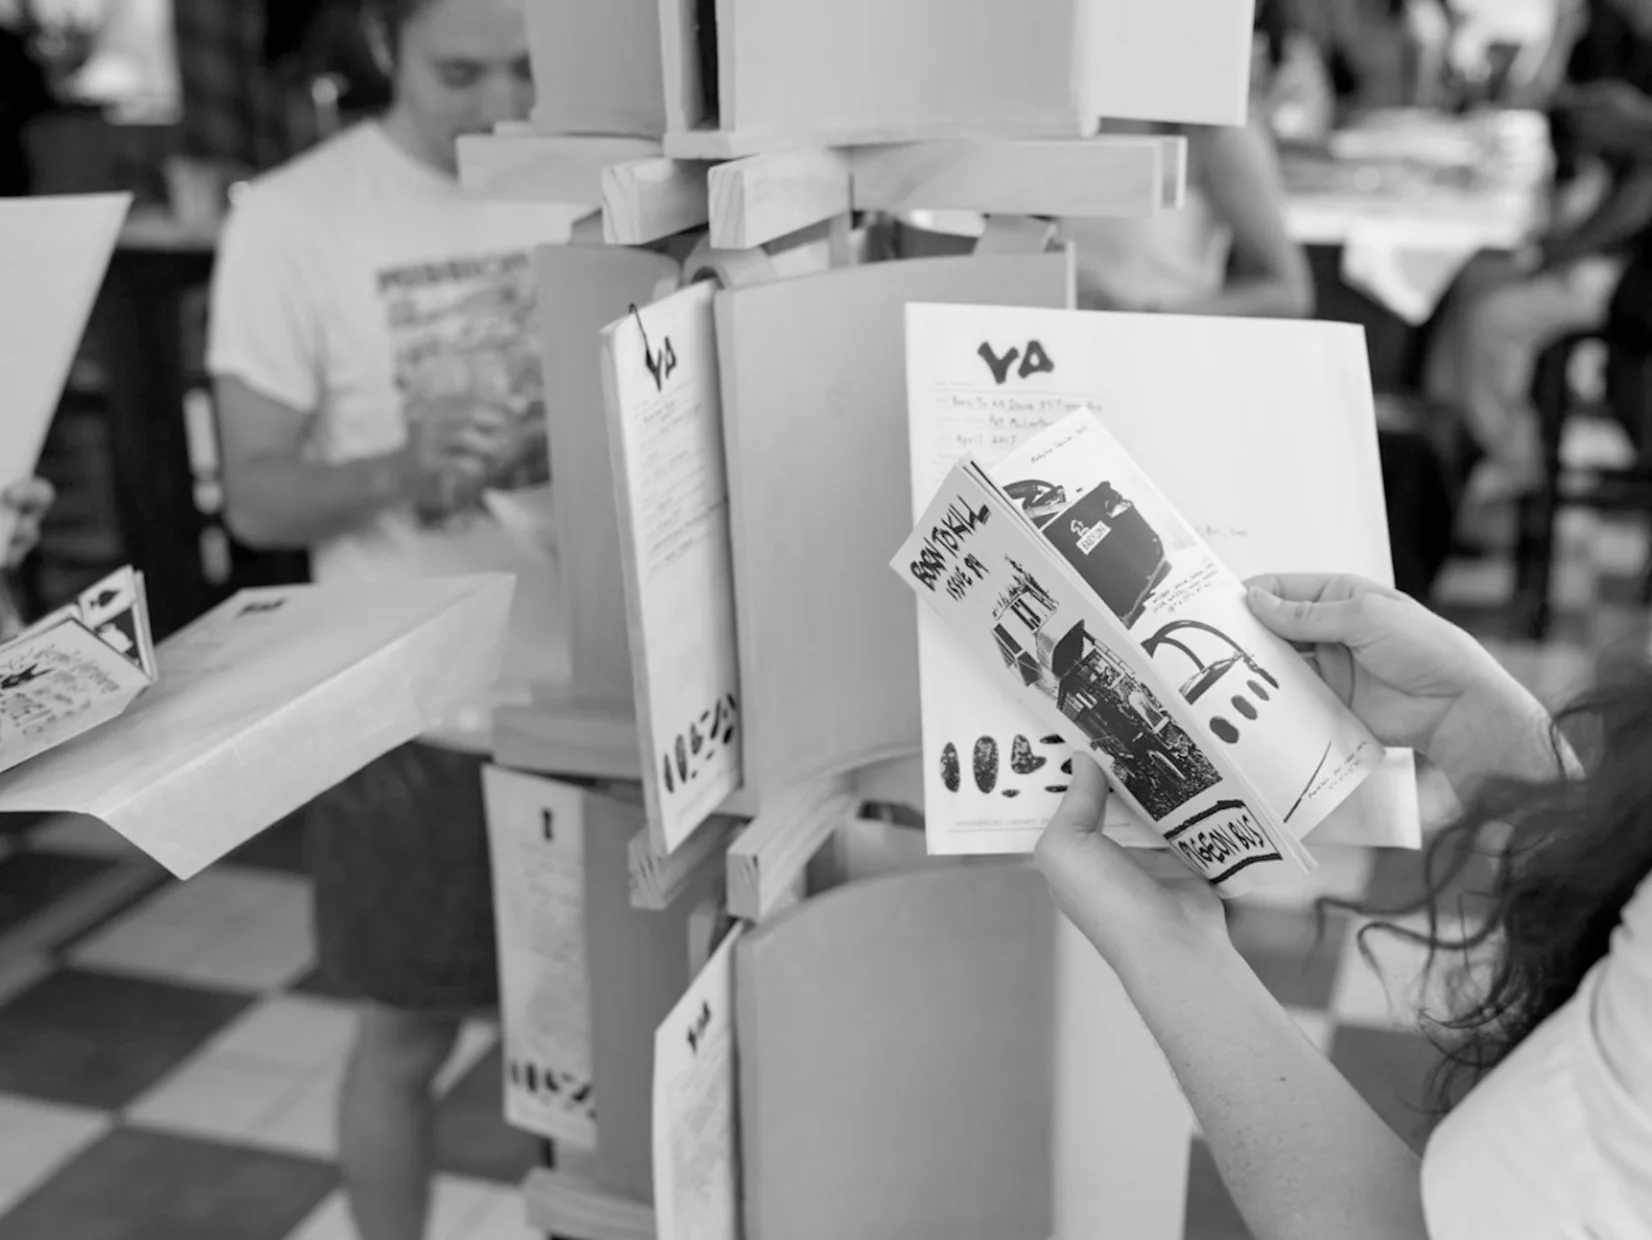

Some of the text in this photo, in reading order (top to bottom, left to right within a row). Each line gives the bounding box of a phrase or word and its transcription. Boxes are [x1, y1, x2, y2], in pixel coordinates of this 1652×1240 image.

[910, 494, 991, 592] BORN TO KILL
[1227, 815, 1265, 850] BUS
